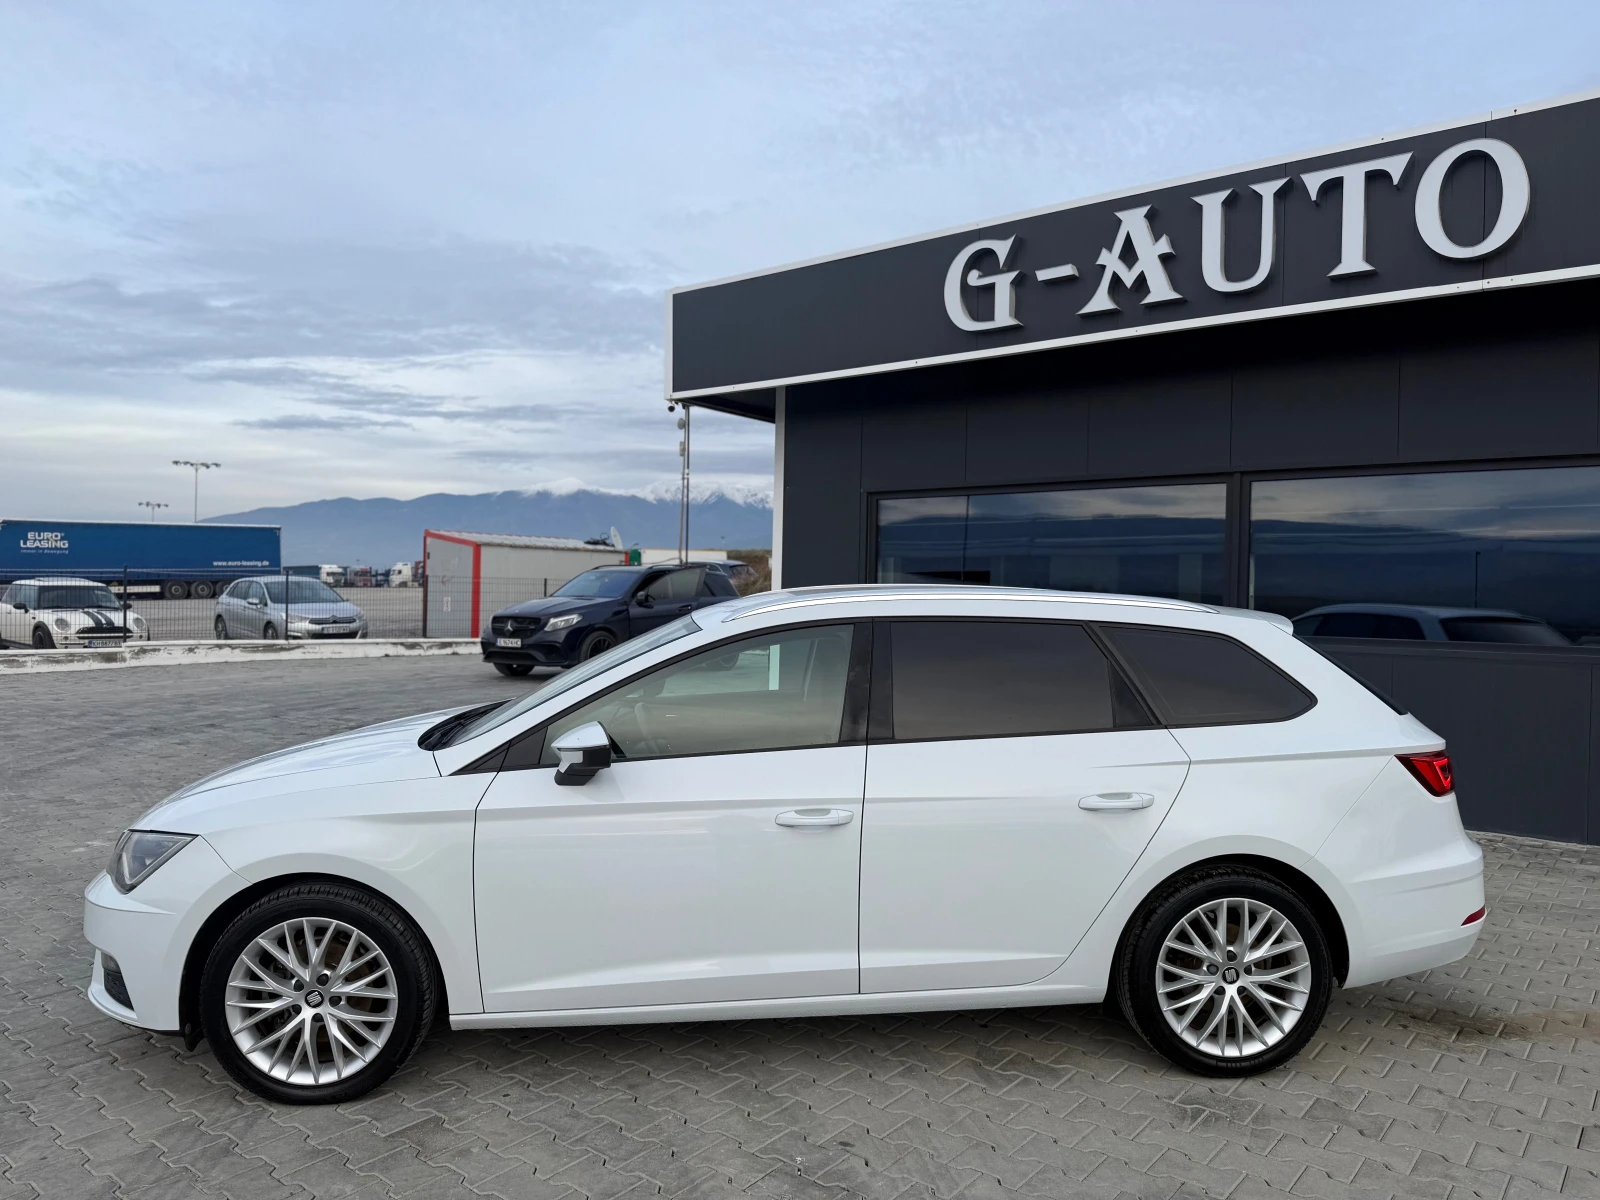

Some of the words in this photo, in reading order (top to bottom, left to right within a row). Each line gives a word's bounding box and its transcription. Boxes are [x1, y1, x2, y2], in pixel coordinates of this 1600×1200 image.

[943, 137, 1531, 332] G-AUTO
[28, 532, 61, 540] EURO
[20, 540, 69, 548] LEASING
